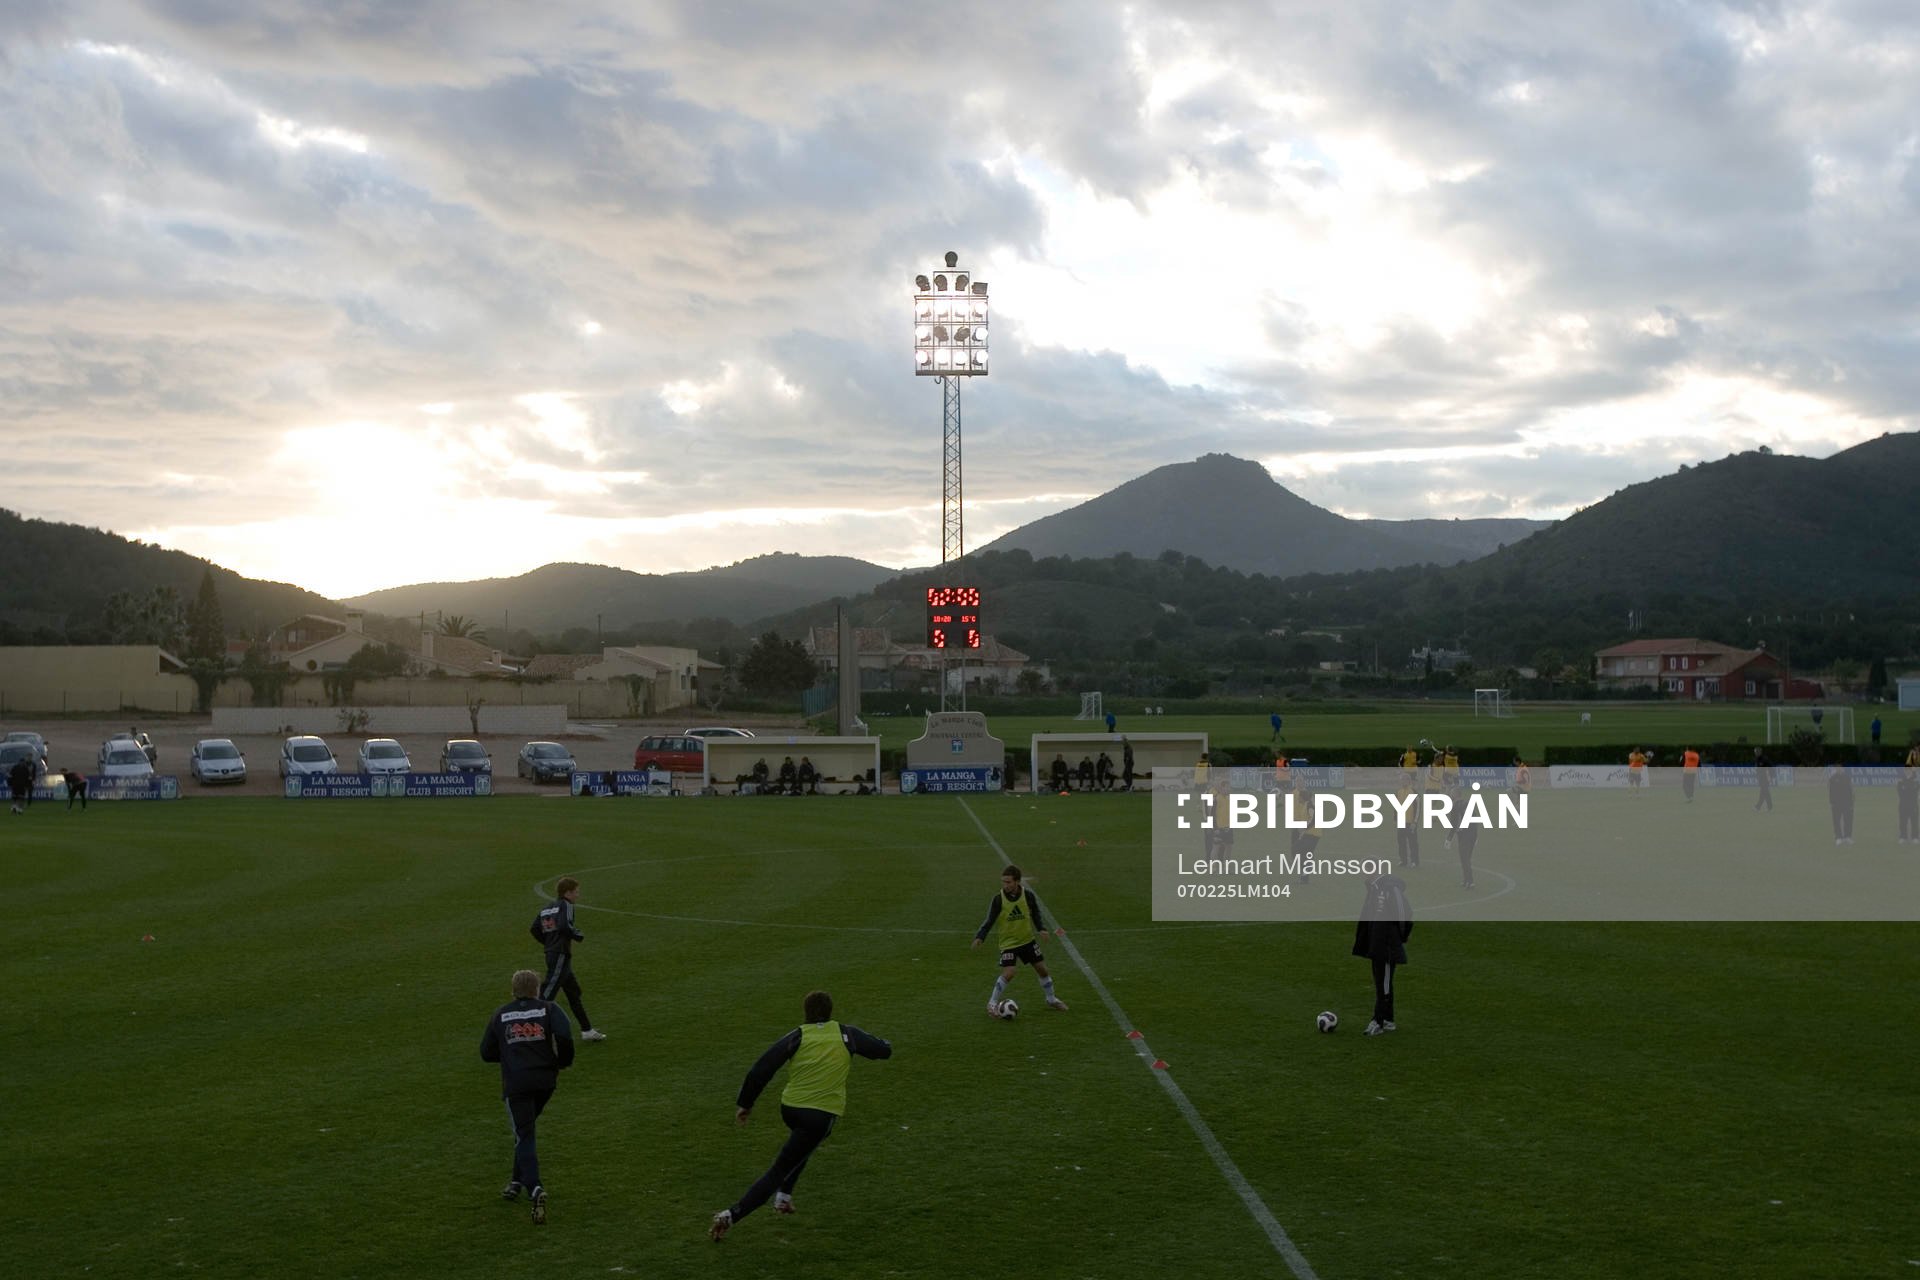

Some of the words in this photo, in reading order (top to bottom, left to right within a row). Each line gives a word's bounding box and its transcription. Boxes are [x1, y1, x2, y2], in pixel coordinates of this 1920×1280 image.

[415, 776, 428, 784] LA
[430, 776, 465, 784] MANGA
[927, 772, 939, 780] LA
[941, 772, 976, 780] MANGA
[100, 778, 113, 786] LA
[116, 778, 150, 786] MANGA
[312, 776, 324, 785] LA
[326, 776, 361, 785] MANGA
[302, 787, 327, 796] CLUB
[332, 787, 370, 796] RESORT
[406, 786, 430, 796] CLUB
[436, 786, 474, 796] RESORT
